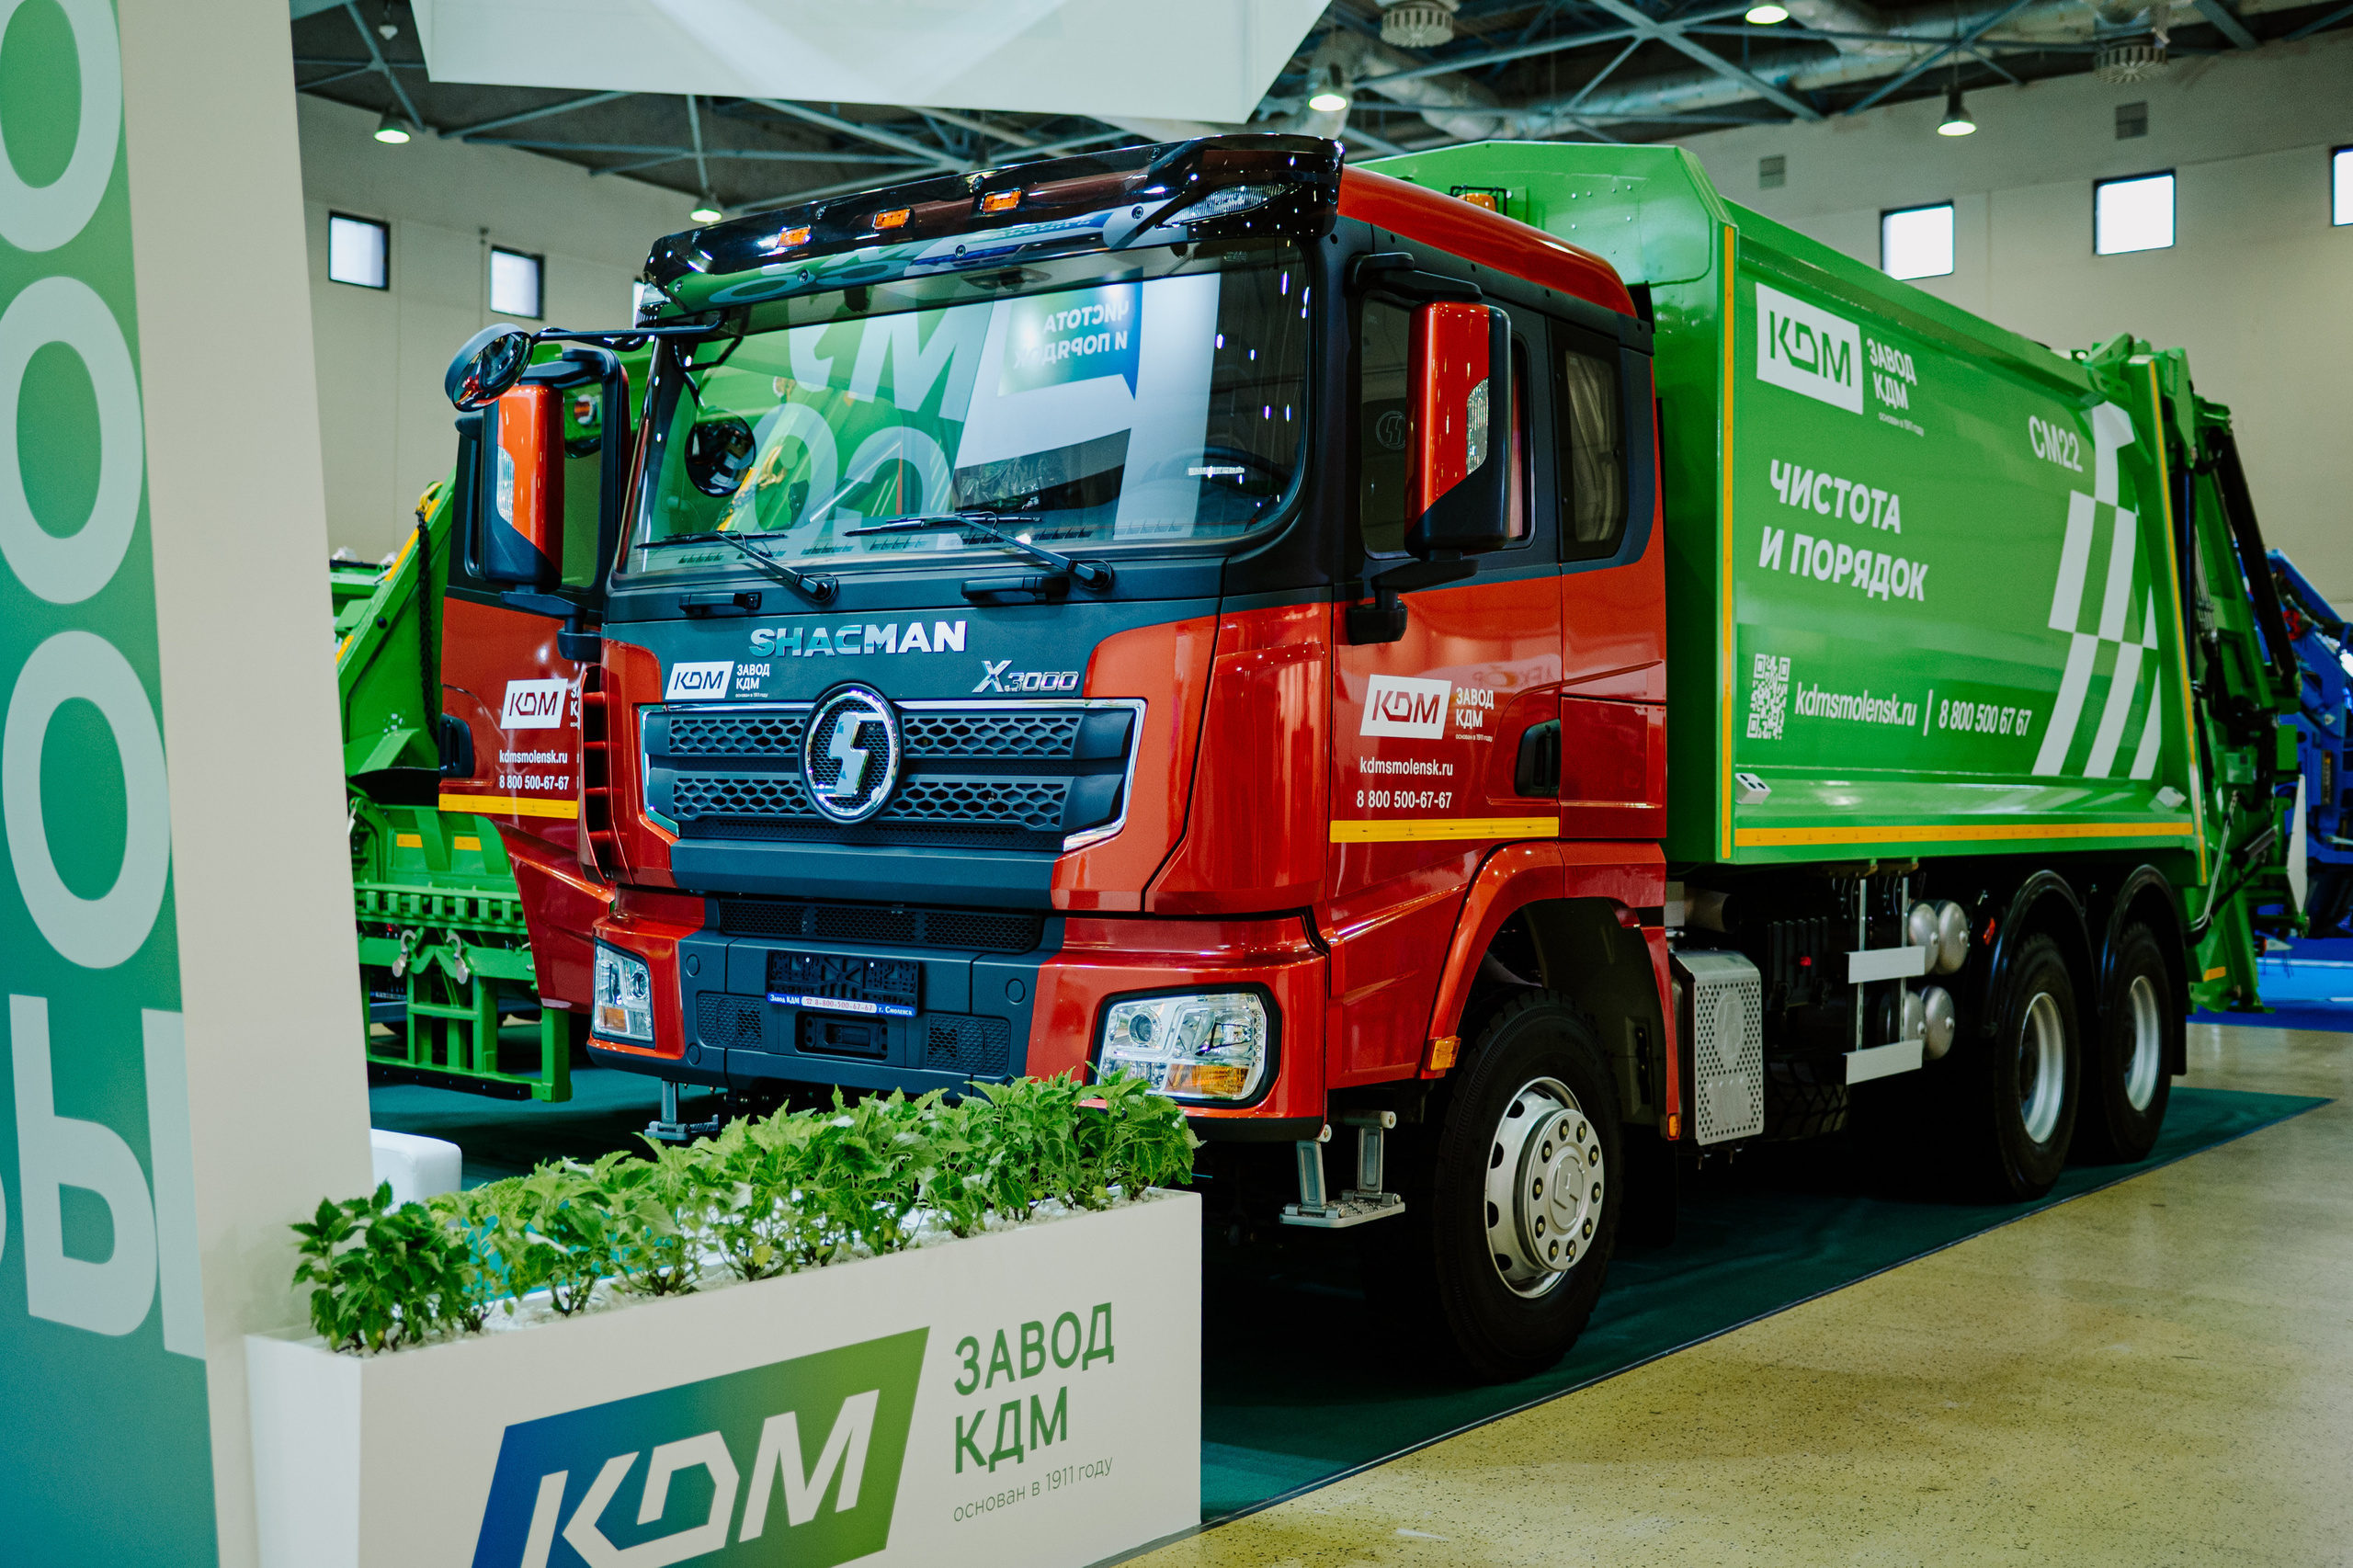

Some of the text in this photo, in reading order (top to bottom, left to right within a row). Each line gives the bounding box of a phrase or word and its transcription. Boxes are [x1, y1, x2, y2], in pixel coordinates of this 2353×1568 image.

[1867, 337, 1917, 386] ЗАВОД
[1872, 370, 1909, 411] КДМ
[1770, 459, 1902, 535] ЧИСТОТА
[1758, 526, 1929, 602] И ПОРЯДОК
[748, 620, 967, 657] SHACMAN
[736, 663, 770, 678] ЗАВОД
[736, 677, 760, 691] КДМ
[971, 660, 1080, 694] X3000
[1456, 687, 1495, 710] ЗАВОД
[1794, 681, 2033, 737] kdmsmolensk.ru 8 800 500 67 67
[1455, 709, 1483, 730] КДМ
[499, 749, 568, 764] kdmsmolensk.ru
[1359, 756, 1453, 777] kdmsmolensk.ru
[499, 775, 570, 790] 8 800 500-67-67
[1357, 790, 1453, 809] 8 800 500-67-67
[814, 999, 873, 1012] 8-800-500-67-67
[954, 1301, 1115, 1396] ЗАВОД
[955, 1386, 1067, 1474] КДМ
[953, 1457, 1113, 1522] основан в 1911 году
